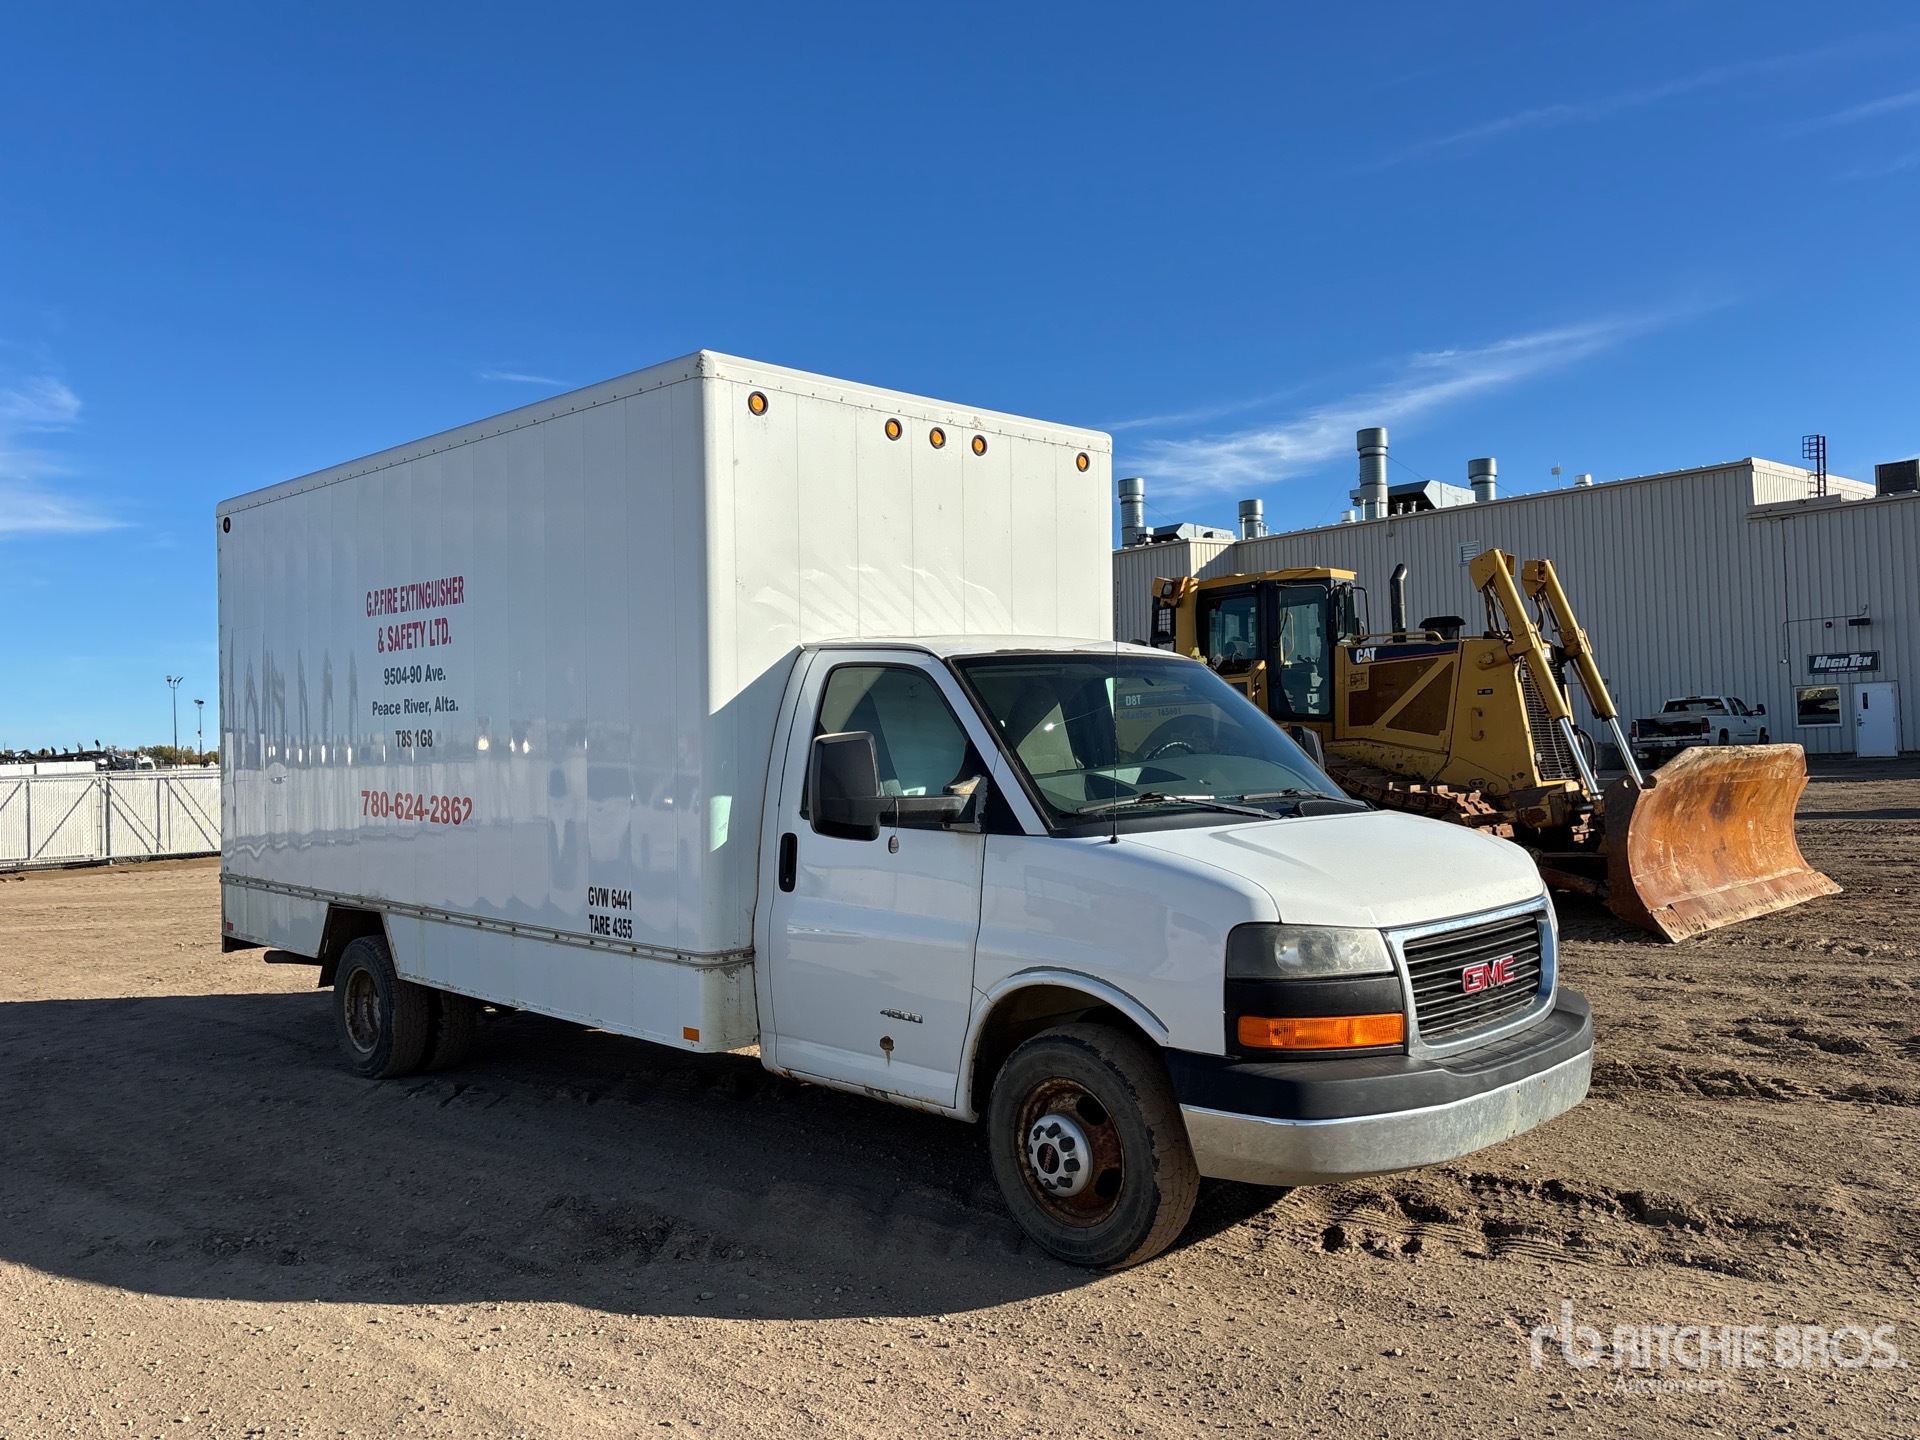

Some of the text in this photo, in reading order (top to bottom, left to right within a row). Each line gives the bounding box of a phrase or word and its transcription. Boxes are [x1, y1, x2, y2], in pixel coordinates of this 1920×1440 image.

[400, 576, 464, 612] EXTINGUISHER
[378, 618, 452, 653] & SAFETY LTD.
[1356, 647, 1377, 664] CAT
[384, 664, 446, 685] 9504-90 Ave.
[372, 696, 459, 716] Peace River, Alta.
[1125, 695, 1141, 706] D8T
[395, 729, 433, 747] T8S 1G8
[361, 790, 473, 826] 780-624-2862
[588, 886, 632, 911] GVW 6441
[589, 914, 632, 939] TARE 4355
[1462, 955, 1515, 993] GMC
[879, 1007, 923, 1024] 4500
